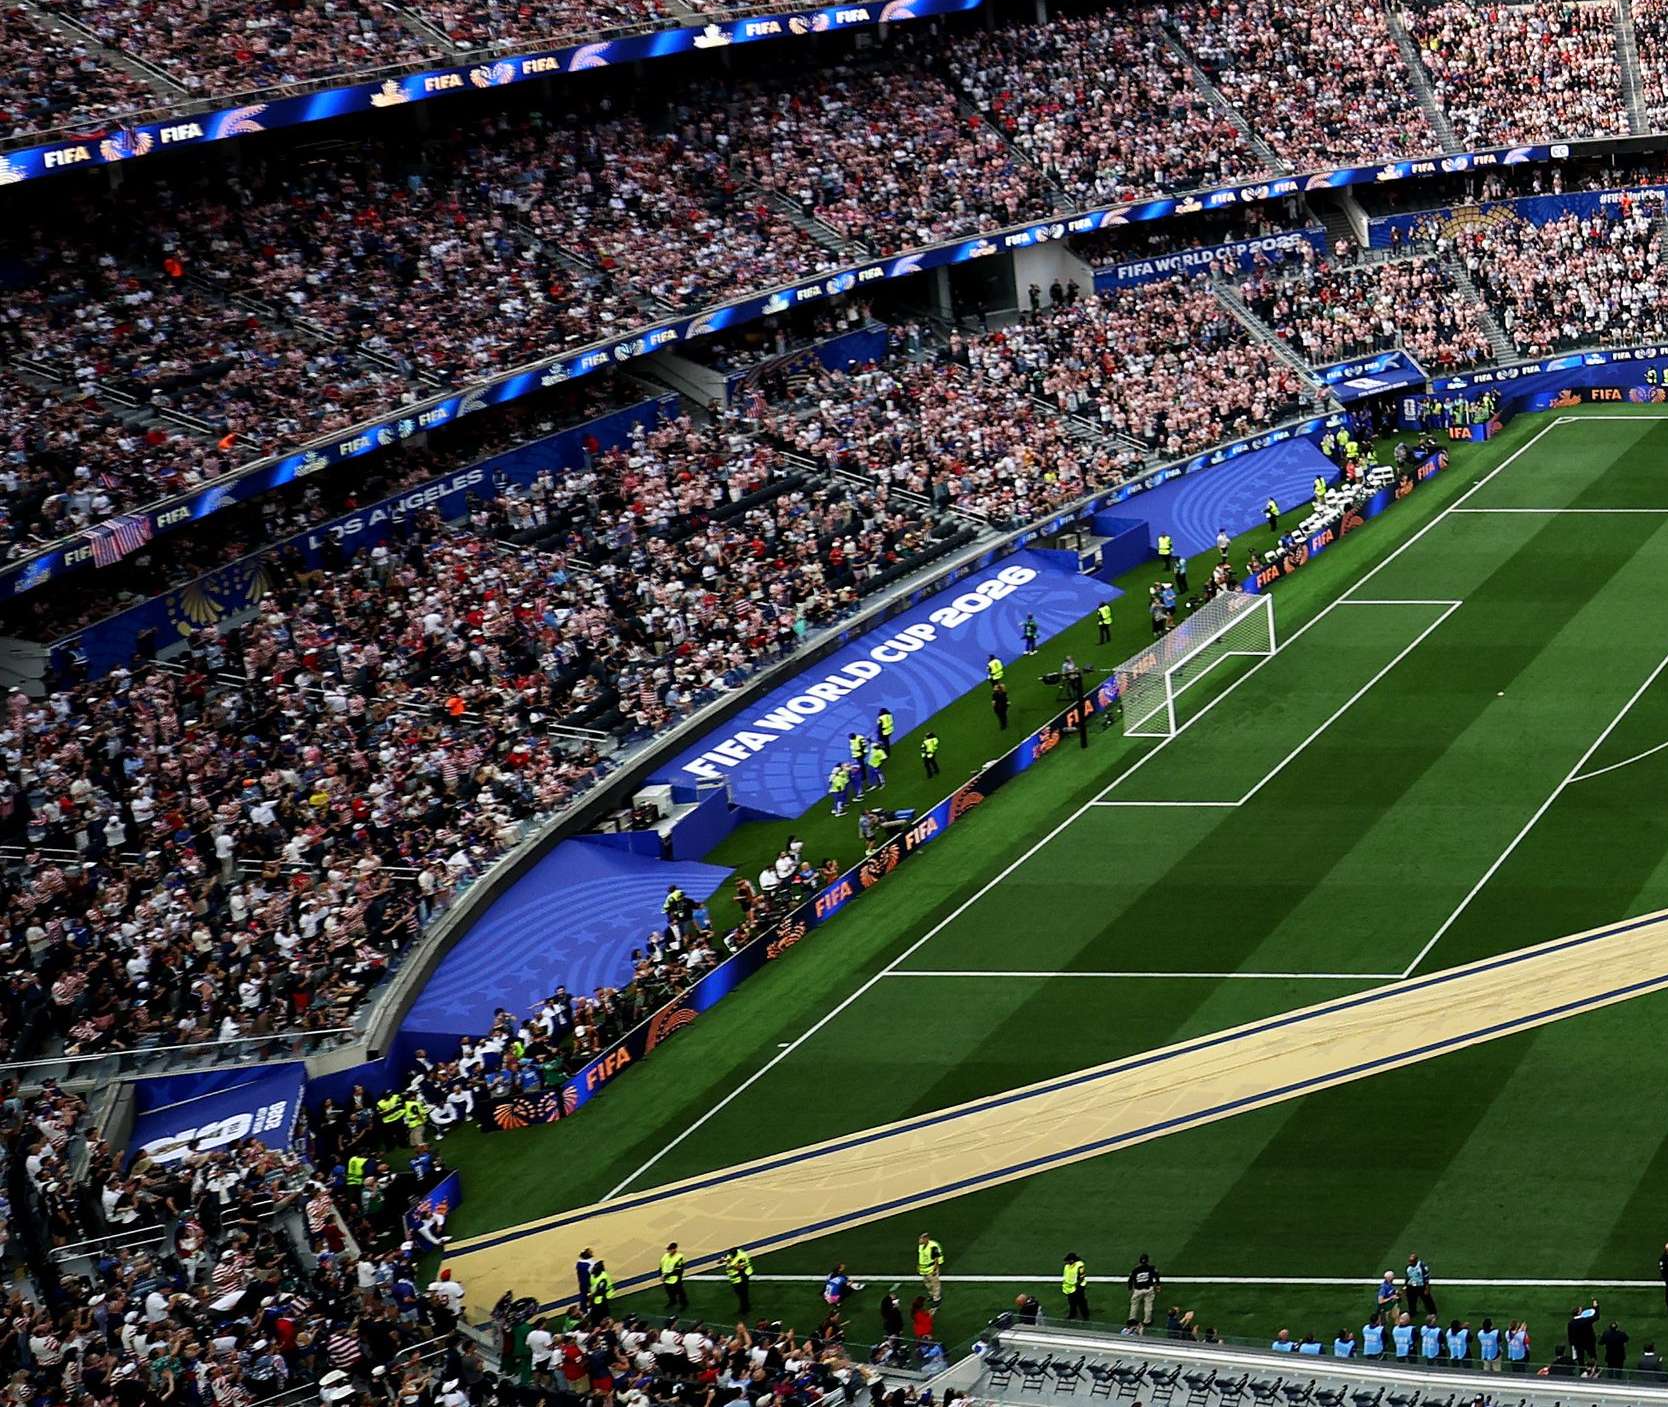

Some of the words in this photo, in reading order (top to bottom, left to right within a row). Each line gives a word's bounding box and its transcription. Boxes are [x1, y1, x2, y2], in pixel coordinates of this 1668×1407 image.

[835, 8, 870, 24] FIFA
[745, 20, 781, 36] FIFA
[522, 57, 560, 74] FIFA
[424, 74, 464, 92] FIFA
[160, 123, 203, 144] FIFA
[44, 145, 91, 169] FIFA
[1473, 153, 1496, 165] FIFA
[1411, 162, 1434, 173] FIFA
[1274, 181, 1298, 193] FIFA
[1211, 191, 1235, 204] FIFA
[1068, 217, 1092, 232] FIFA
[1004, 232, 1030, 246] FIFA
[1117, 263, 1154, 279] FIFA
[1154, 248, 1214, 274] WORLD
[1215, 244, 1248, 262] CUP
[1249, 233, 1303, 254] 2026
[859, 266, 884, 282] FIFA
[797, 286, 822, 301] FIFA
[650, 330, 677, 345] FIFA
[581, 353, 608, 368] FIFA
[1364, 361, 1379, 371] FIFA
[1591, 388, 1622, 400] FIFA
[419, 409, 447, 427] FIFA
[1449, 427, 1472, 440] IFA
[339, 434, 371, 455] FIFA
[1417, 460, 1435, 481] FIFA
[157, 506, 190, 529] FIFA
[1312, 528, 1333, 551] FIFA
[65, 547, 92, 567] FIF
[1257, 566, 1280, 590] FIFA
[683, 730, 780, 779] FIFA
[752, 662, 883, 732] WORLD
[870, 622, 938, 663] CUP
[928, 565, 1038, 628] 2026
[1066, 699, 1093, 728] FIA
[906, 818, 937, 851] FIFA
[816, 881, 852, 918] FIFA
[587, 1047, 632, 1091] FIFA
